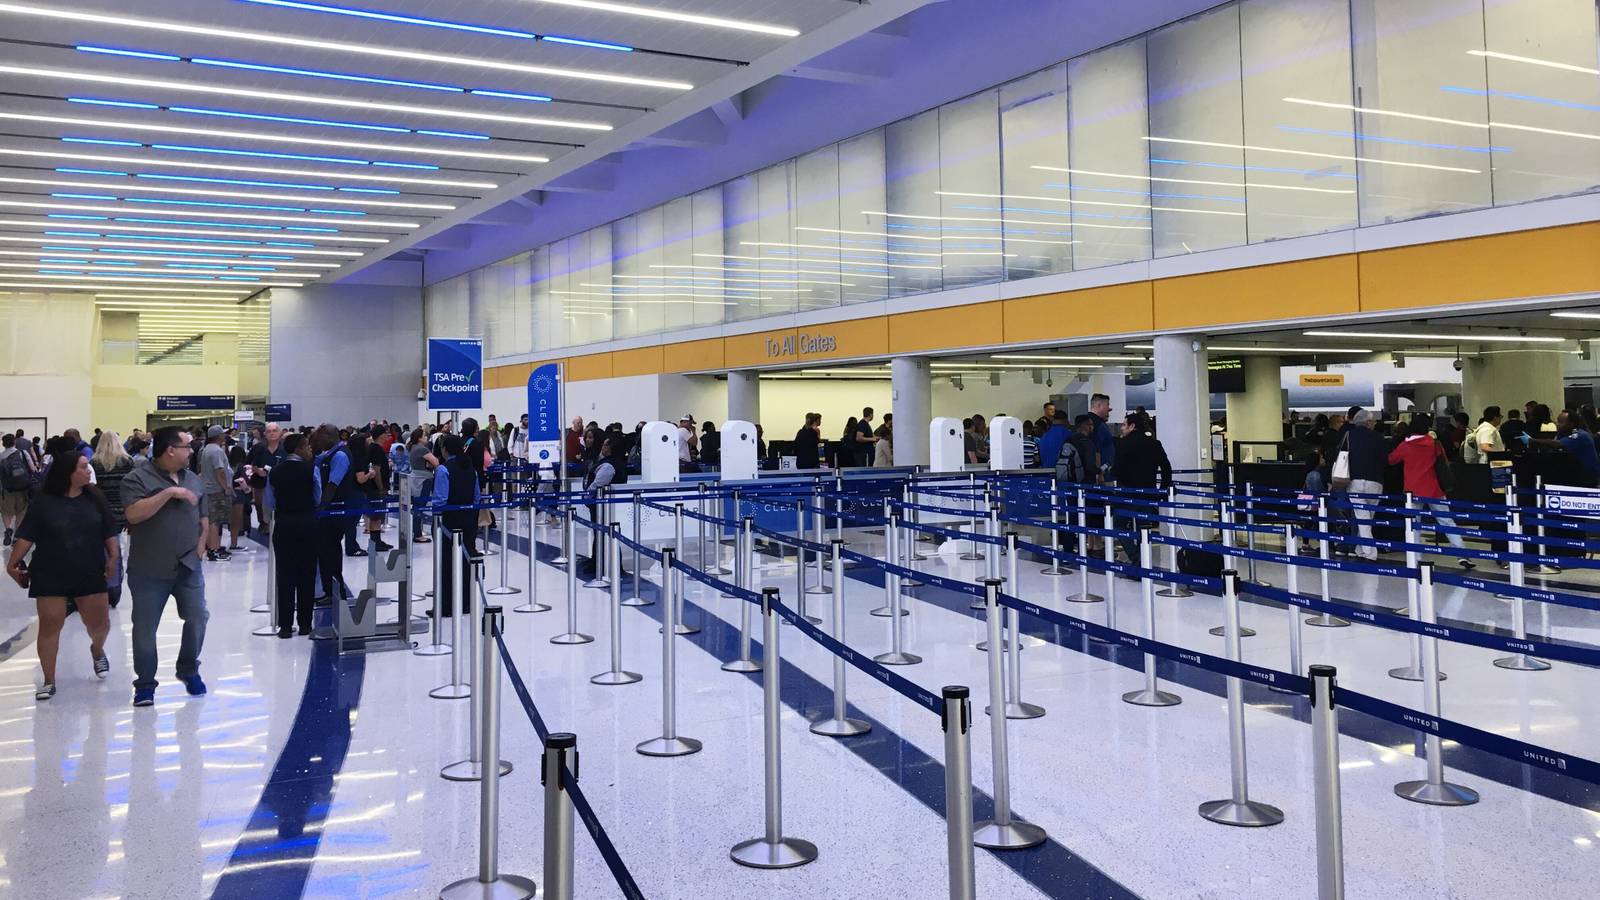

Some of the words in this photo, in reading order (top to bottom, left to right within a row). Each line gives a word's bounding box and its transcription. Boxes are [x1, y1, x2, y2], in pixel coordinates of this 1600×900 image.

[766, 336, 779, 356] To
[783, 335, 796, 355] All
[800, 334, 836, 354] Gates
[434, 373, 449, 381] TSA
[451, 373, 464, 381] Pre
[432, 384, 479, 392] Checkpoint
[1180, 653, 1196, 662] UNITED
[1250, 671, 1268, 680] UNITED
[1404, 714, 1430, 727] UNITED
[1524, 750, 1556, 765] UNITED
